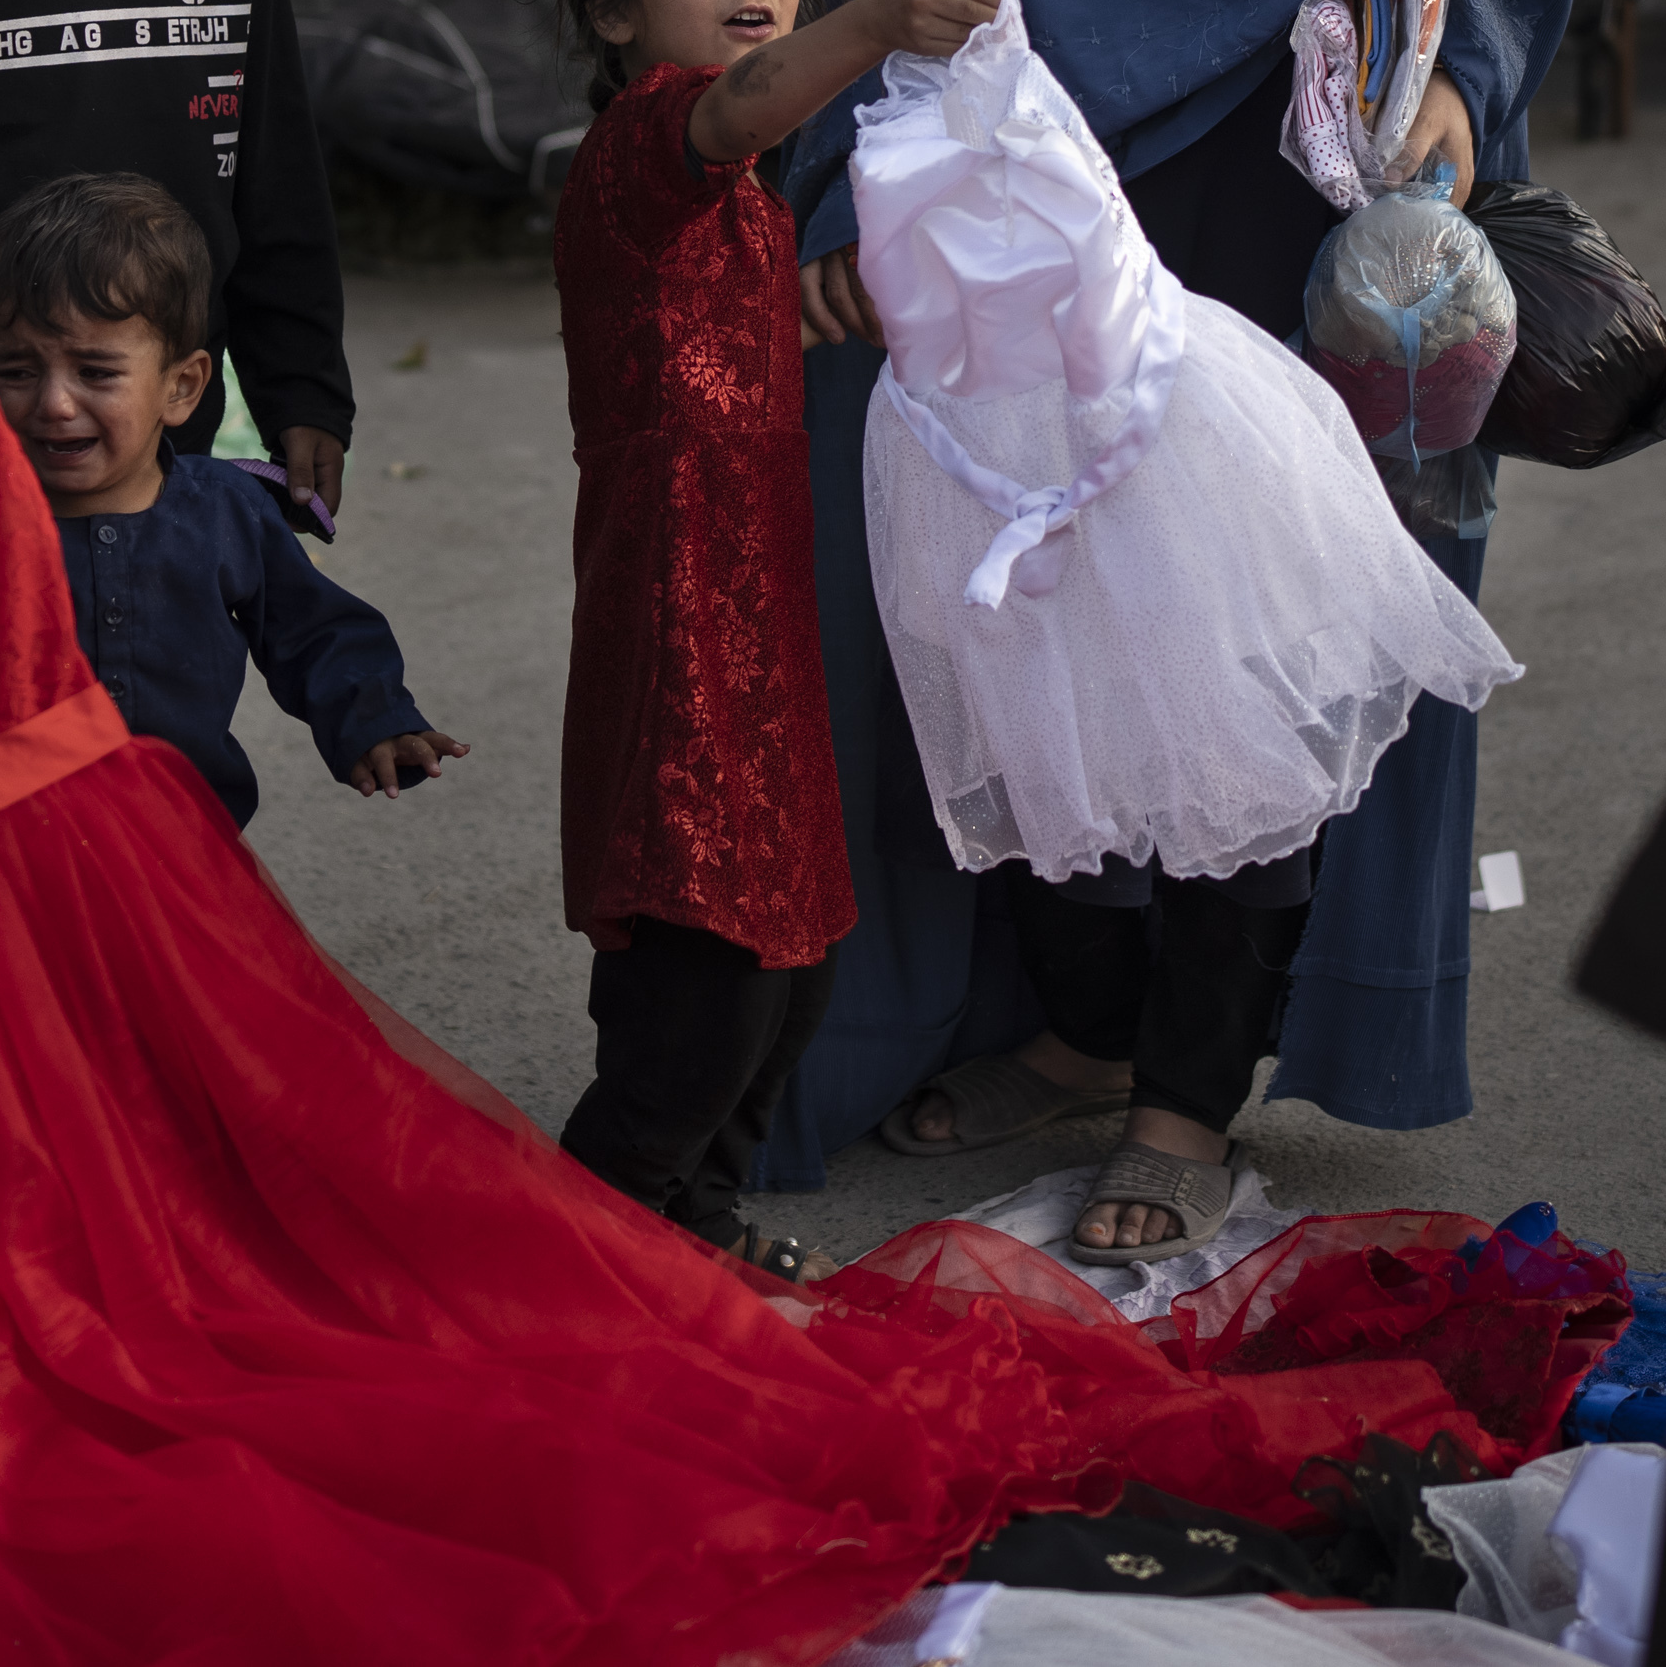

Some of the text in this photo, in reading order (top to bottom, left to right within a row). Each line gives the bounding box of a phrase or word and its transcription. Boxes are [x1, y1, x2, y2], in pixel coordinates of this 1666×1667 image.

[136, 20, 151, 45] S
[167, 17, 229, 44] ETRJH
[188, 93, 239, 120] NEVER
[217, 151, 237, 177] ZO
